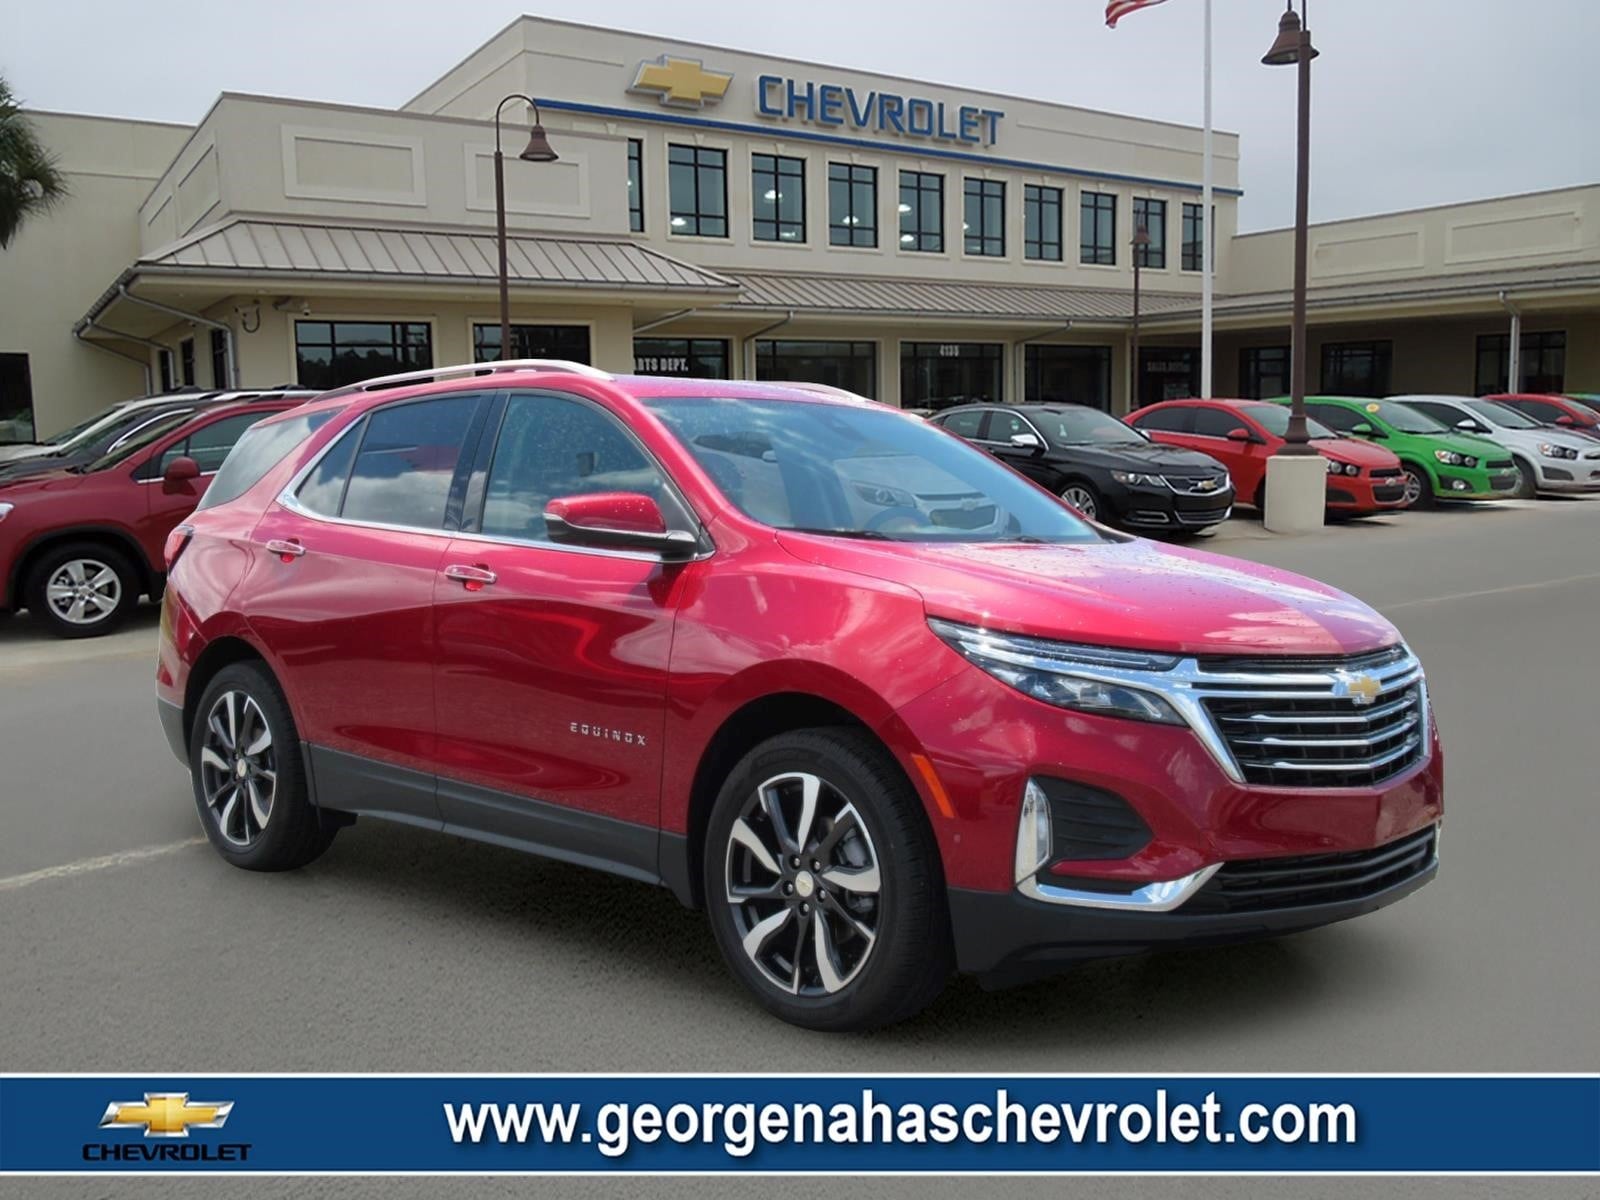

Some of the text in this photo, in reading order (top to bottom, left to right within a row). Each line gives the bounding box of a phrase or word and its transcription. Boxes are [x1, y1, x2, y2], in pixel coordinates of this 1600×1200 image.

[757, 74, 1005, 145] CHEVROLET
[660, 357, 689, 371] DEPT.
[569, 721, 646, 746] EQUINOX
